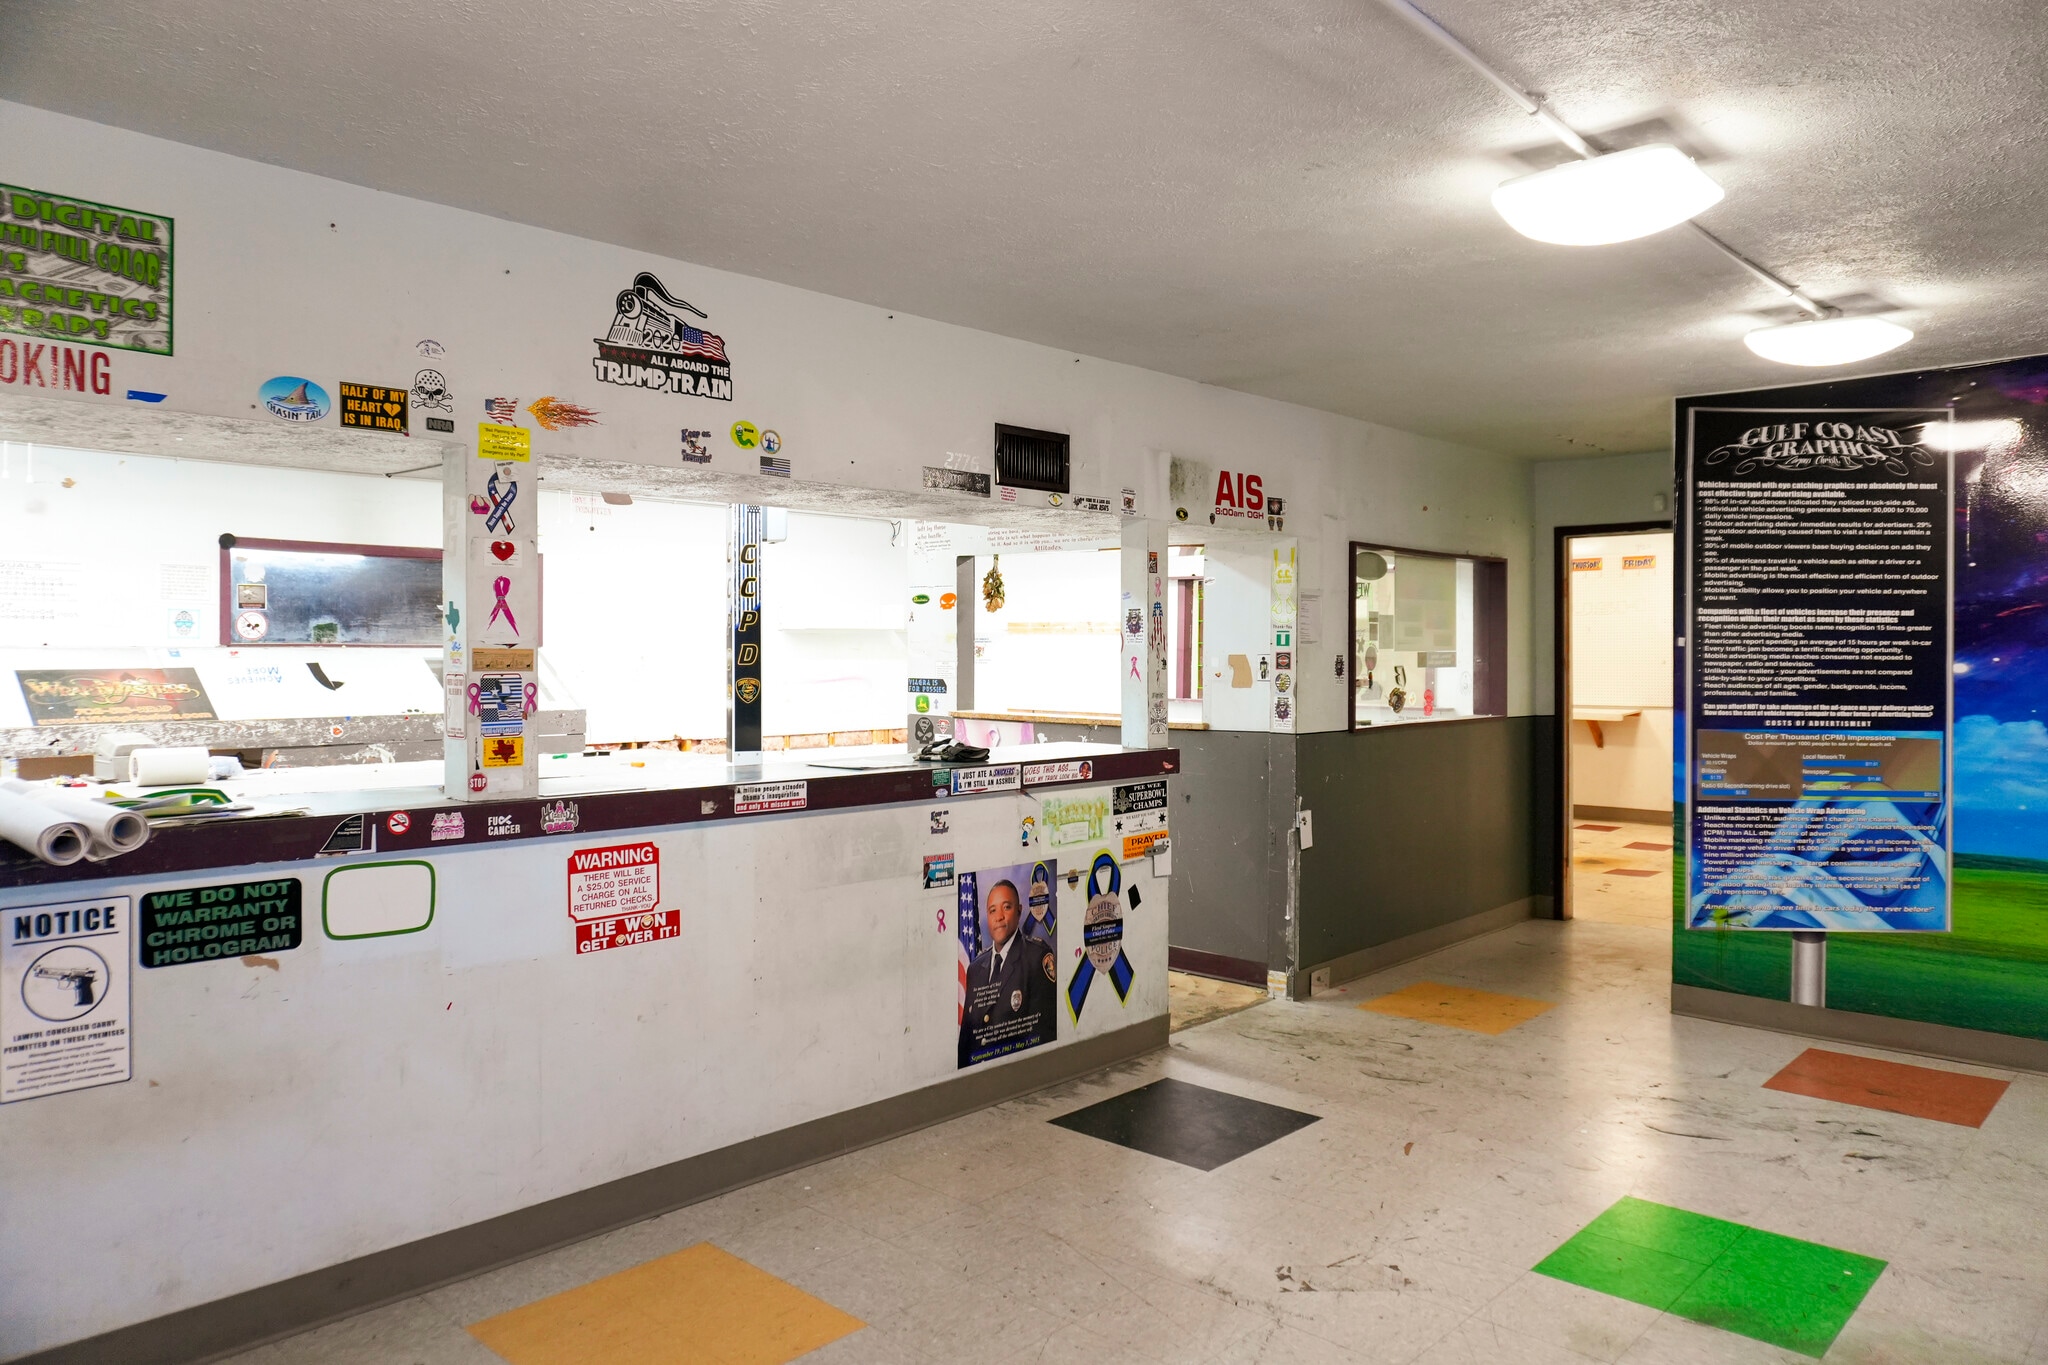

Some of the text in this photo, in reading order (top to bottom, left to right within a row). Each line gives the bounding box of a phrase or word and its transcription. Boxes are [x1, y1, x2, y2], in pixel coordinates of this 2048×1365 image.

[10, 193, 156, 242] DIGITAL
[42, 231, 89, 263] FULL
[96, 243, 160, 288] COLOR
[643, 330, 681, 351] 2020
[651, 355, 729, 376] ALL ABOARD THE
[595, 359, 731, 400] TRUMP TRAIN
[342, 385, 405, 402] HALF OF MY
[267, 401, 322, 420] CHASIN' TAIL
[348, 400, 382, 413] HEART
[345, 413, 355, 424] IS
[360, 415, 371, 426] IN
[428, 419, 453, 432] NRA
[1742, 422, 1901, 447] GULF COAST
[1765, 440, 1886, 460] GRAPHICS
[1216, 471, 1263, 510] AIS
[1215, 508, 1244, 517] 8:00am
[1573, 561, 1601, 569] THURSDAY
[958, 772, 961, 780] I
[962, 771, 976, 780] JUST
[978, 770, 987, 778] ATE
[993, 767, 1015, 777] SNICKERS
[1024, 766, 1041, 775] DOES
[1043, 764, 1055, 774] THIS
[470, 779, 486, 788] STOP
[996, 777, 1016, 785] ASSHOLE
[767, 791, 799, 799] inauguration
[1129, 789, 1166, 802] SUPERBOWL
[771, 800, 789, 808] missed
[1133, 799, 1162, 810] CHAMPS
[488, 825, 520, 836] CANCER
[575, 847, 653, 870] WARNING
[584, 872, 610, 882] THERE
[614, 870, 631, 878] WILL
[587, 881, 614, 892] $25.00
[618, 876, 651, 886] SERVICE
[151, 881, 292, 910] WE DO NOT
[582, 891, 615, 901] CHARGE
[633, 886, 647, 894] ALL
[574, 894, 654, 912] RETURNED CHECKS.
[1091, 902, 1117, 916] CHIEF
[154, 900, 288, 928] WARRANTY
[14, 906, 116, 940] NOTICE
[592, 921, 616, 938] HE
[146, 916, 296, 948] CHROME OR
[580, 937, 609, 953] GET
[660, 926, 677, 938] IT!
[152, 934, 290, 966] HOLOGRAM
[1091, 942, 1117, 954] POLICE
[13, 1020, 116, 1042] LAWFUL CONCEALED CARRY
[4, 1029, 125, 1054] PERMITTED ON THESE PREMISES
[971, 1051, 994, 1062] September
[1016, 1042, 1024, 1050] May
